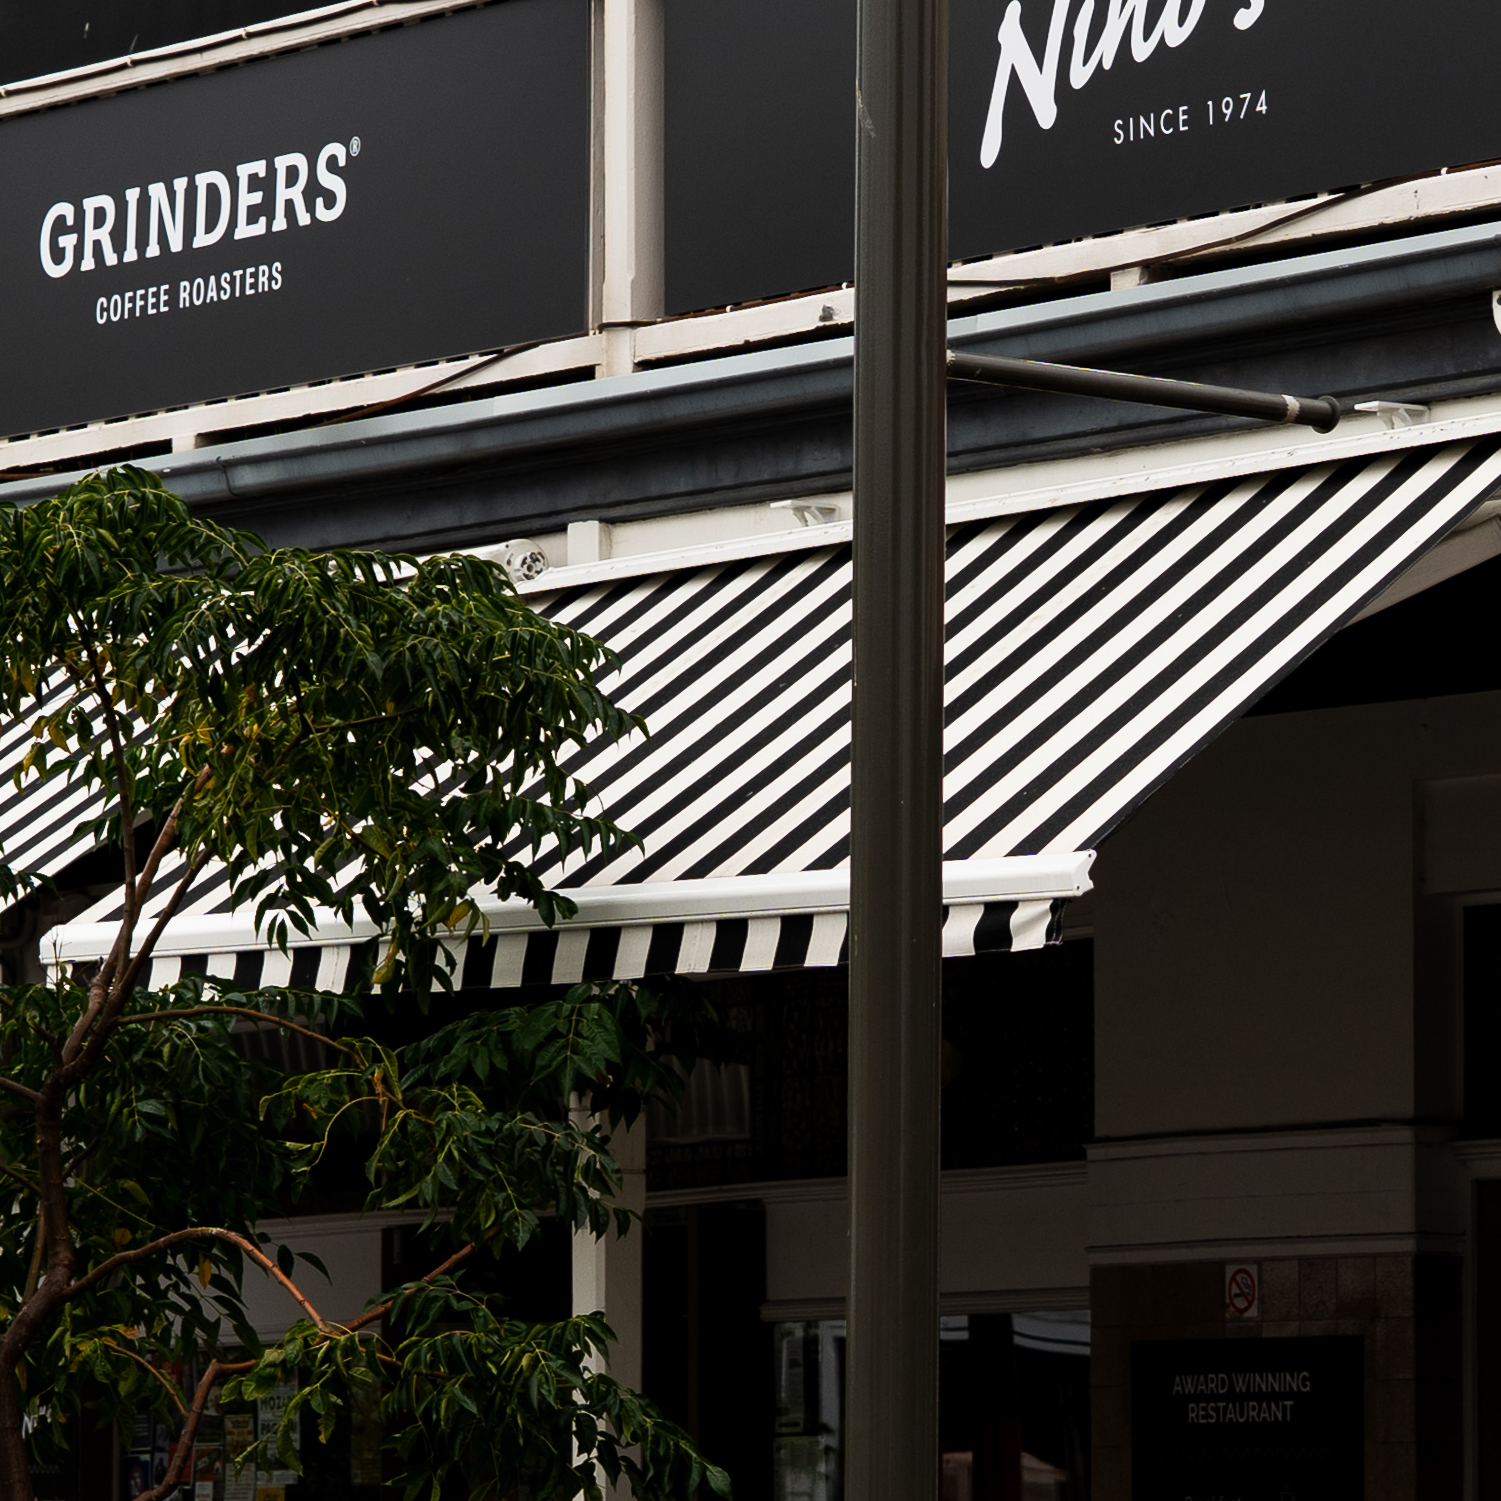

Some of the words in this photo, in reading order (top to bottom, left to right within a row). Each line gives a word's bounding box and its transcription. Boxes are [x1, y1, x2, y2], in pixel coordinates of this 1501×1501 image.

[1113, 105, 1190, 145] SINCE
[1207, 89, 1268, 125] 1974
[96, 284, 170, 325] COFFEE
[179, 261, 283, 309] ROASTERS
[1172, 1373, 1230, 1396] AWARD
[1231, 1371, 1312, 1394] WINNING
[1187, 1400, 1296, 1424] RESTAURANT
